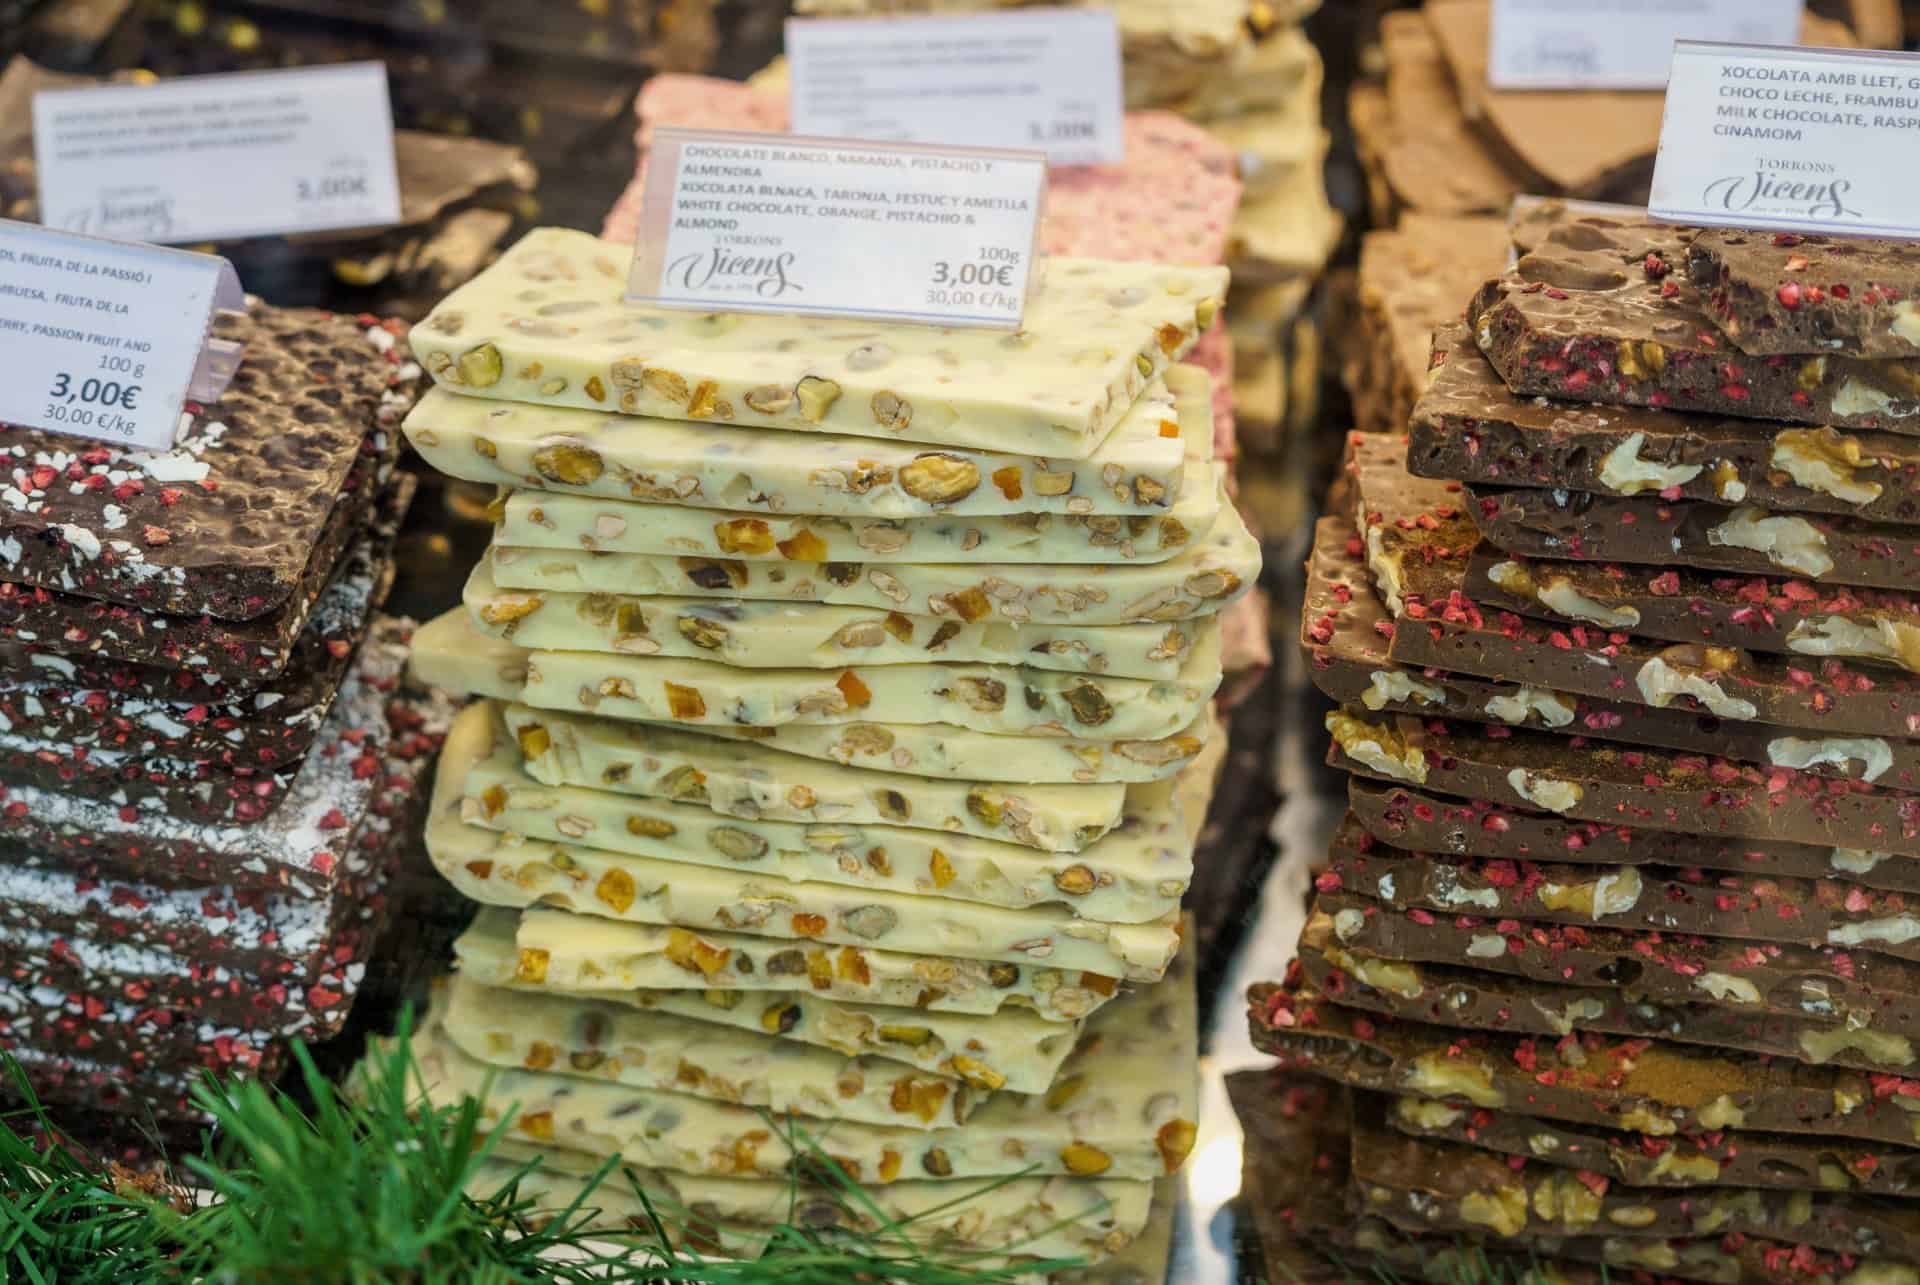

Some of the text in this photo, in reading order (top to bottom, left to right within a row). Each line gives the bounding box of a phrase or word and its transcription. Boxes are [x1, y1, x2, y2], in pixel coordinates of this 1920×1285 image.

[1721, 65, 1811, 83] XOCOLATA
[1816, 72, 1857, 86] AMB
[1861, 75, 1903, 91] LLET,
[1719, 86, 1919, 110] CHOCO LECHE, FRAMBU
[1716, 104, 1920, 131] MILK CHOCOLATE, RASP
[1713, 123, 1802, 142] CINAMOM
[683, 164, 762, 178] ALMENDRA
[686, 146, 993, 173] CHOCOLATE BLANCO, NARANJA, PISTACHO Y
[1756, 157, 1835, 173] TORRONS
[681, 182, 755, 196] XOCOLATA
[823, 189, 891, 204] TARONJA,
[896, 193, 947, 207] FESTUC
[952, 197, 960, 206] Y
[963, 199, 1028, 211] AMETLLA
[675, 218, 738, 231] ALMOND
[678, 200, 976, 225] WHITE CHOCOLATE, ORANGE, PISTACHIO &
[21, 252, 62, 269] FRUITA
[66, 261, 81, 273] DE
[84, 263, 99, 276] LA
[102, 266, 145, 284] PASSIÓ
[979, 247, 1020, 265] 100g
[932, 261, 1014, 287] 3,00€
[55, 293, 93, 309] FRUTA
[96, 301, 111, 313] DE
[115, 304, 129, 316] LA
[927, 290, 1017, 311] 30,00 €/kg
[32, 323, 84, 342] PASSION
[87, 332, 120, 348] FRUIT
[124, 339, 151, 353] AND
[98, 354, 146, 379] 100 g
[49, 372, 142, 410] 3,00€
[44, 403, 136, 436] 30,00 €/kg
